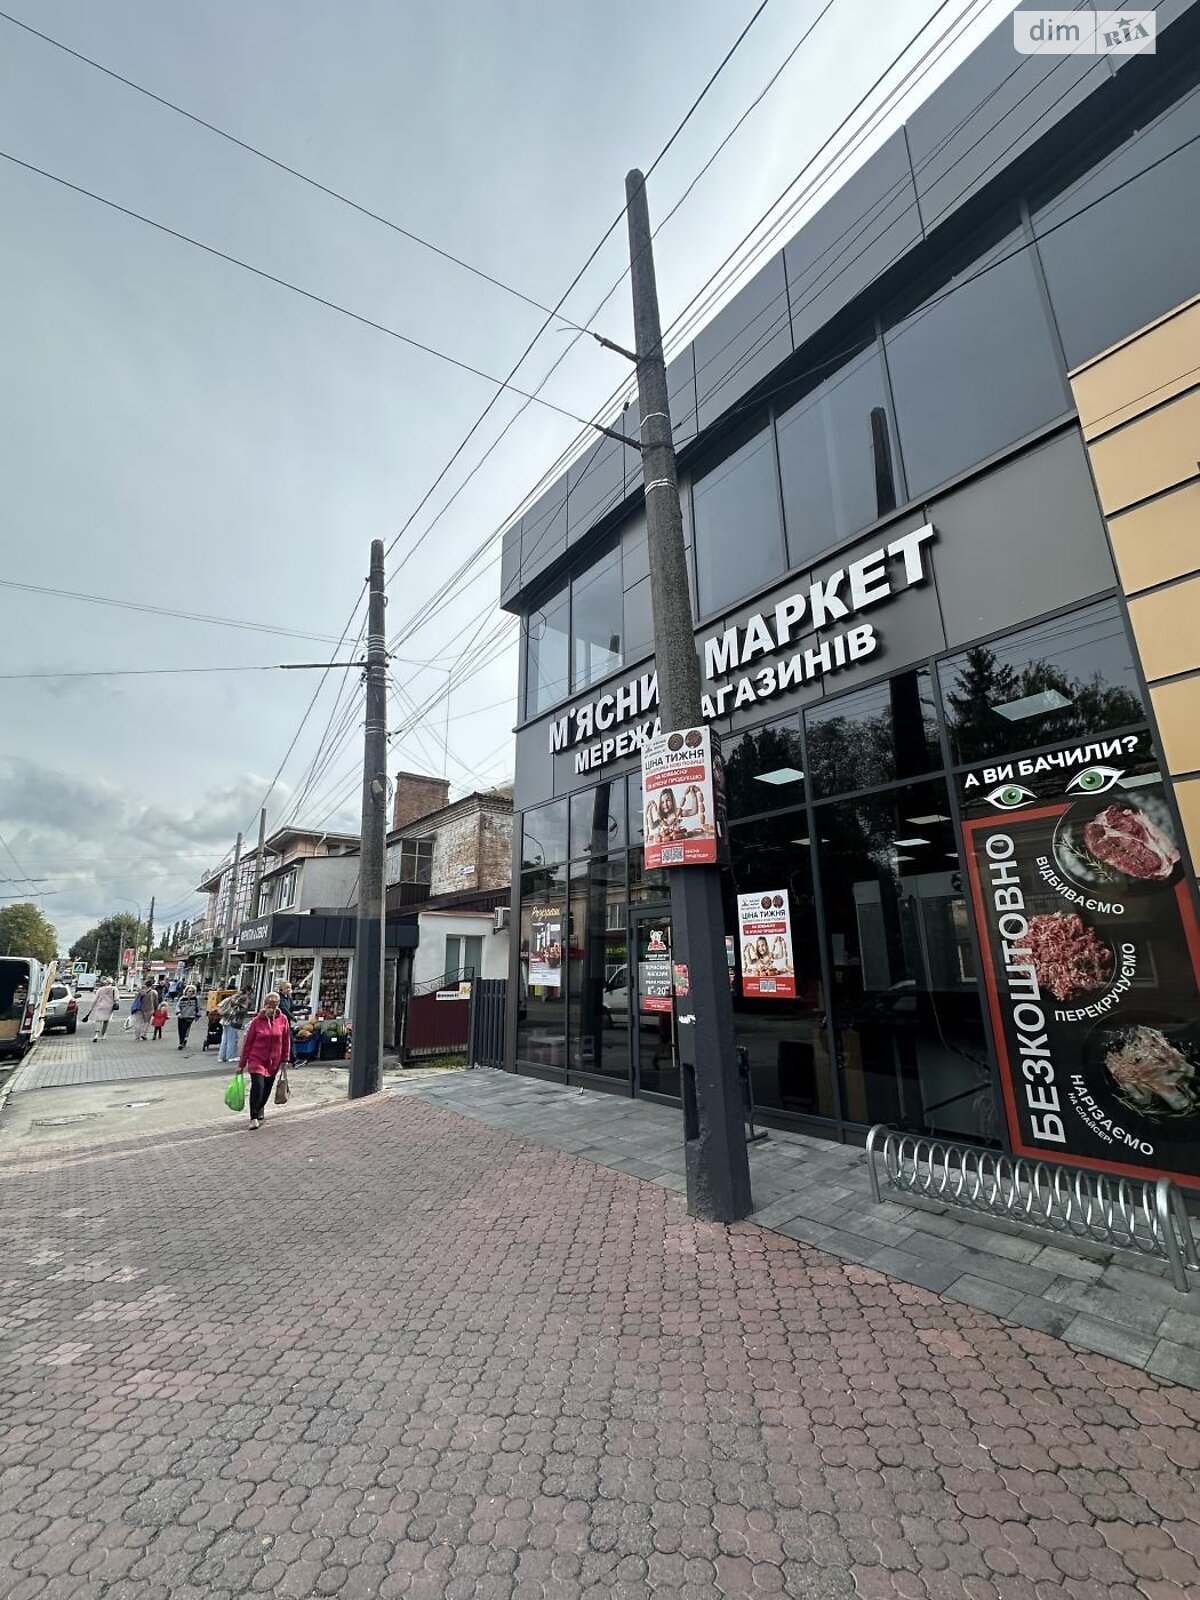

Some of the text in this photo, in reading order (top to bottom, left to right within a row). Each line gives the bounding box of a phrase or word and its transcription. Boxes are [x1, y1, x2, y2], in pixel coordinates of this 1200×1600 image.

[548, 522, 935, 754] М'ЯСНИ МАРКЕТ
[574, 623, 877, 775] МЕРЕЖА АГАЗИНІВ
[665, 749, 705, 764] ТИЖНЯ
[964, 735, 1139, 788] А ВИ БАЧИЛИ?
[1036, 856, 1125, 915] ВІДБИВАЄМО
[985, 833, 1067, 1144] БЕЗКОШТОВНО
[1054, 943, 1137, 1022] ПЕРЕКРУЧУЄМО
[1068, 1092, 1114, 1144] НА СЛАЙСЕРІ
[1070, 1074, 1154, 1156] НАРІЗАЄМО
